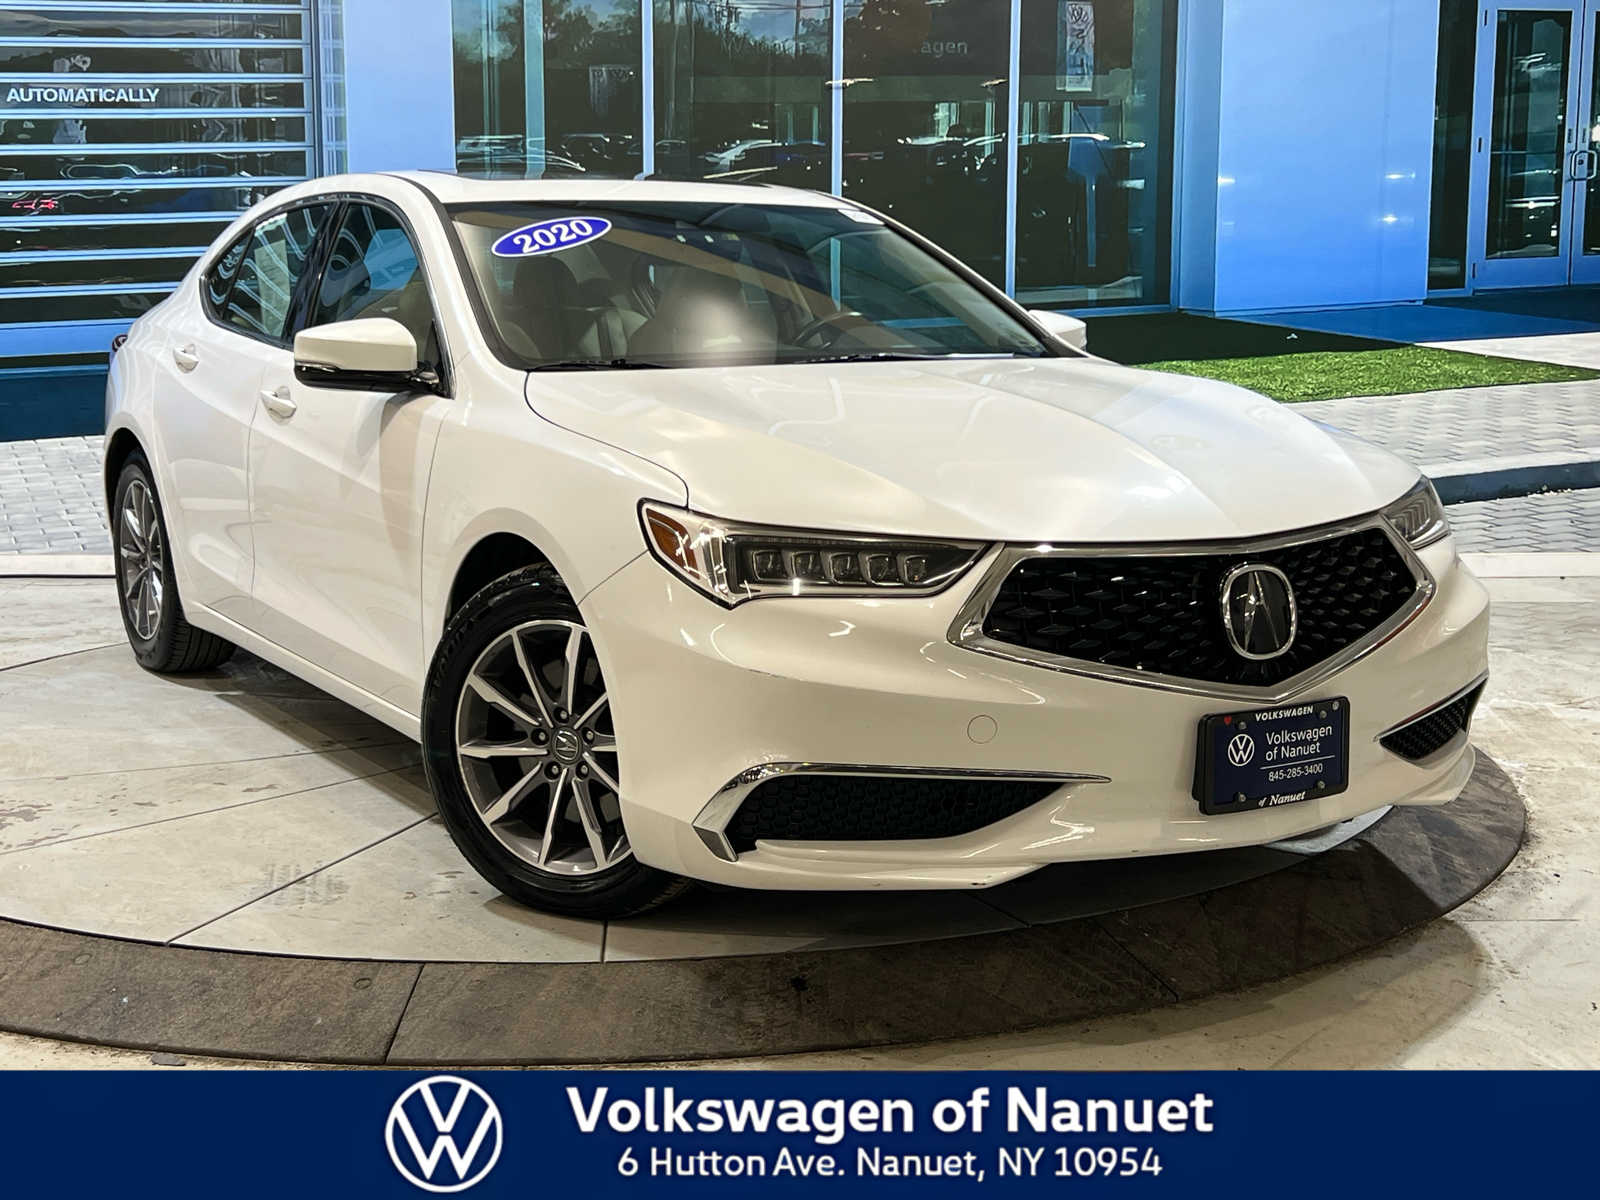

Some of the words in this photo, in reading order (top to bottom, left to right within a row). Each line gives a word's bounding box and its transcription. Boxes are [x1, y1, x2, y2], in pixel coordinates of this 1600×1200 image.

[6, 87, 160, 102] AUTOMATICALLY
[513, 219, 593, 253] 2020
[1255, 705, 1314, 722] VOLKSWAGEN
[1265, 725, 1333, 746] Volkswagen
[1265, 748, 1279, 762] of
[1281, 742, 1321, 760] Nanuet
[1268, 763, 1323, 782] 845-285-3400
[1269, 791, 1306, 806] Nanuet
